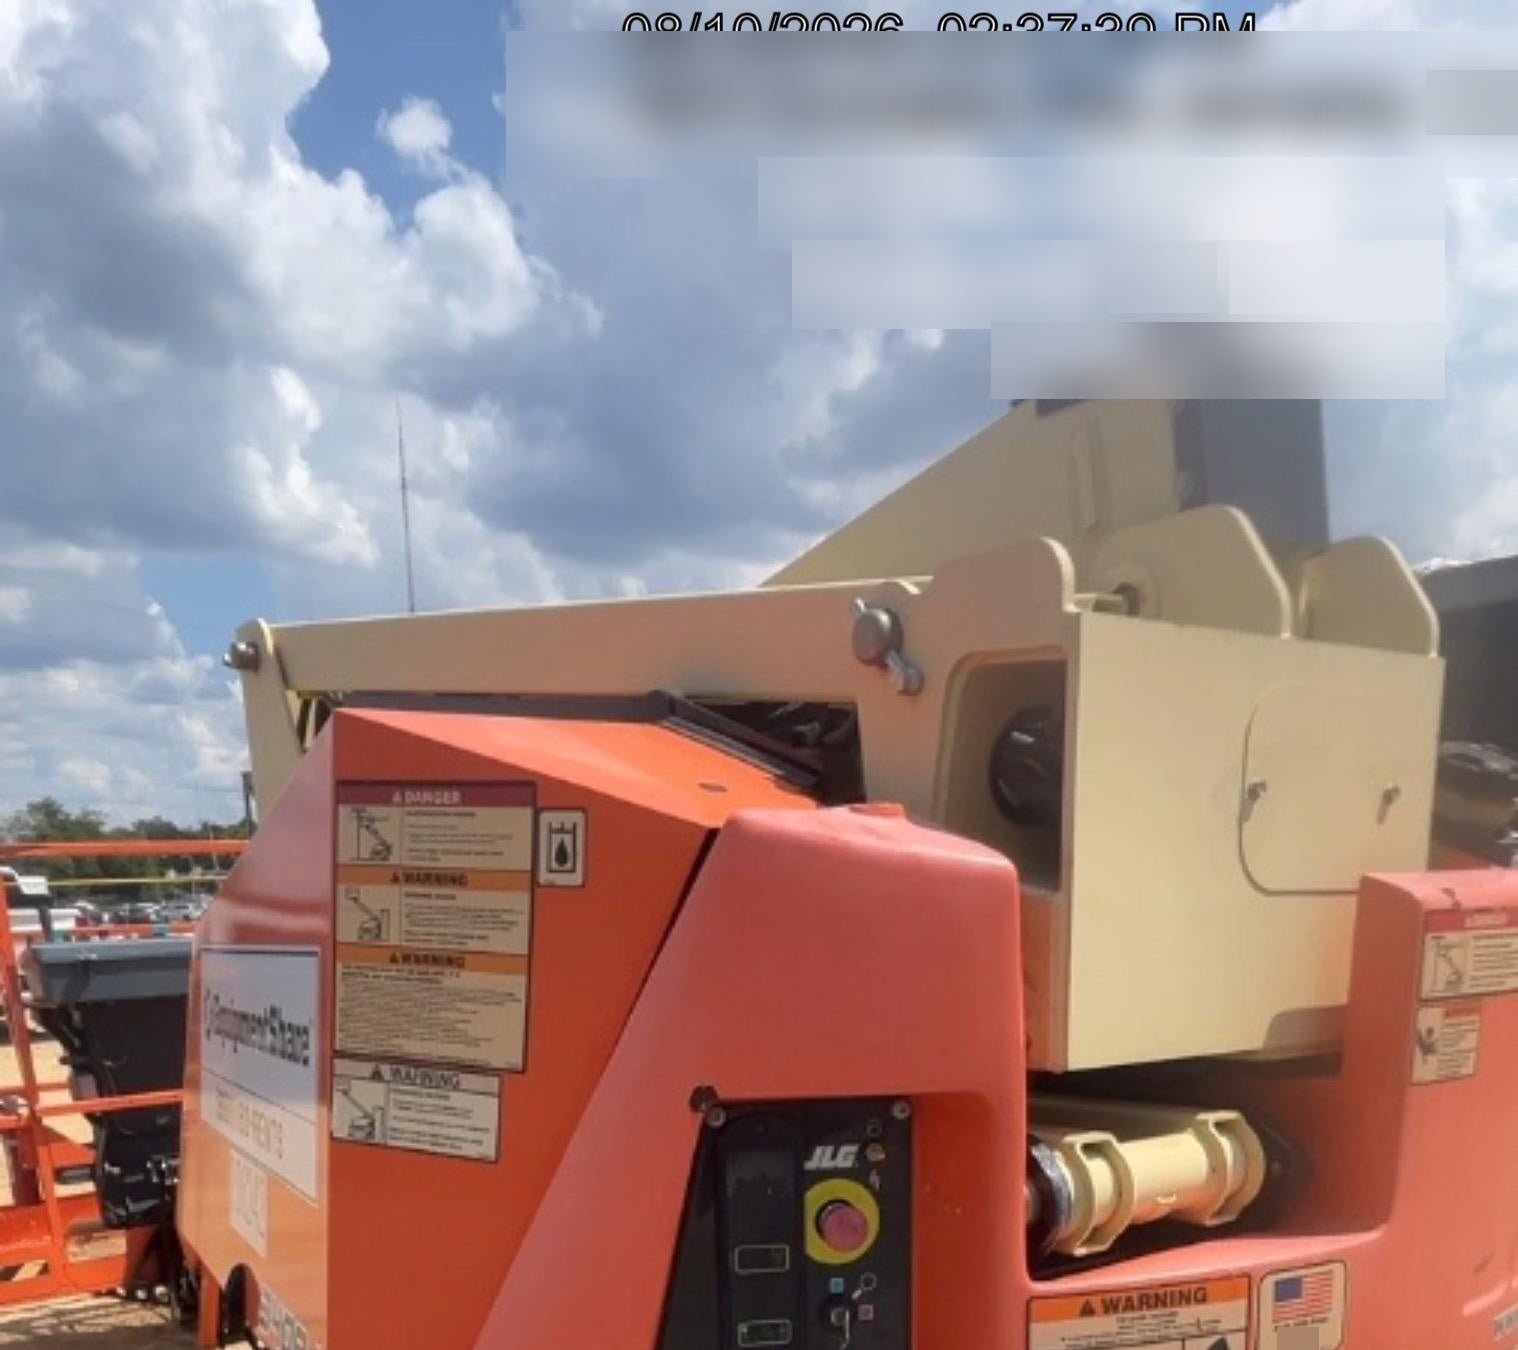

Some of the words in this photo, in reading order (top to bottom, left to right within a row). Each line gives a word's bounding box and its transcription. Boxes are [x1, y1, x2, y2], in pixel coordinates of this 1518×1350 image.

[404, 791, 462, 805] DANGER
[402, 872, 469, 887] WARNING
[401, 953, 466, 969] WARNING
[390, 1064, 461, 1090] WARNING
[803, 1144, 859, 1171] JLG
[1101, 1286, 1207, 1315] WARNING
